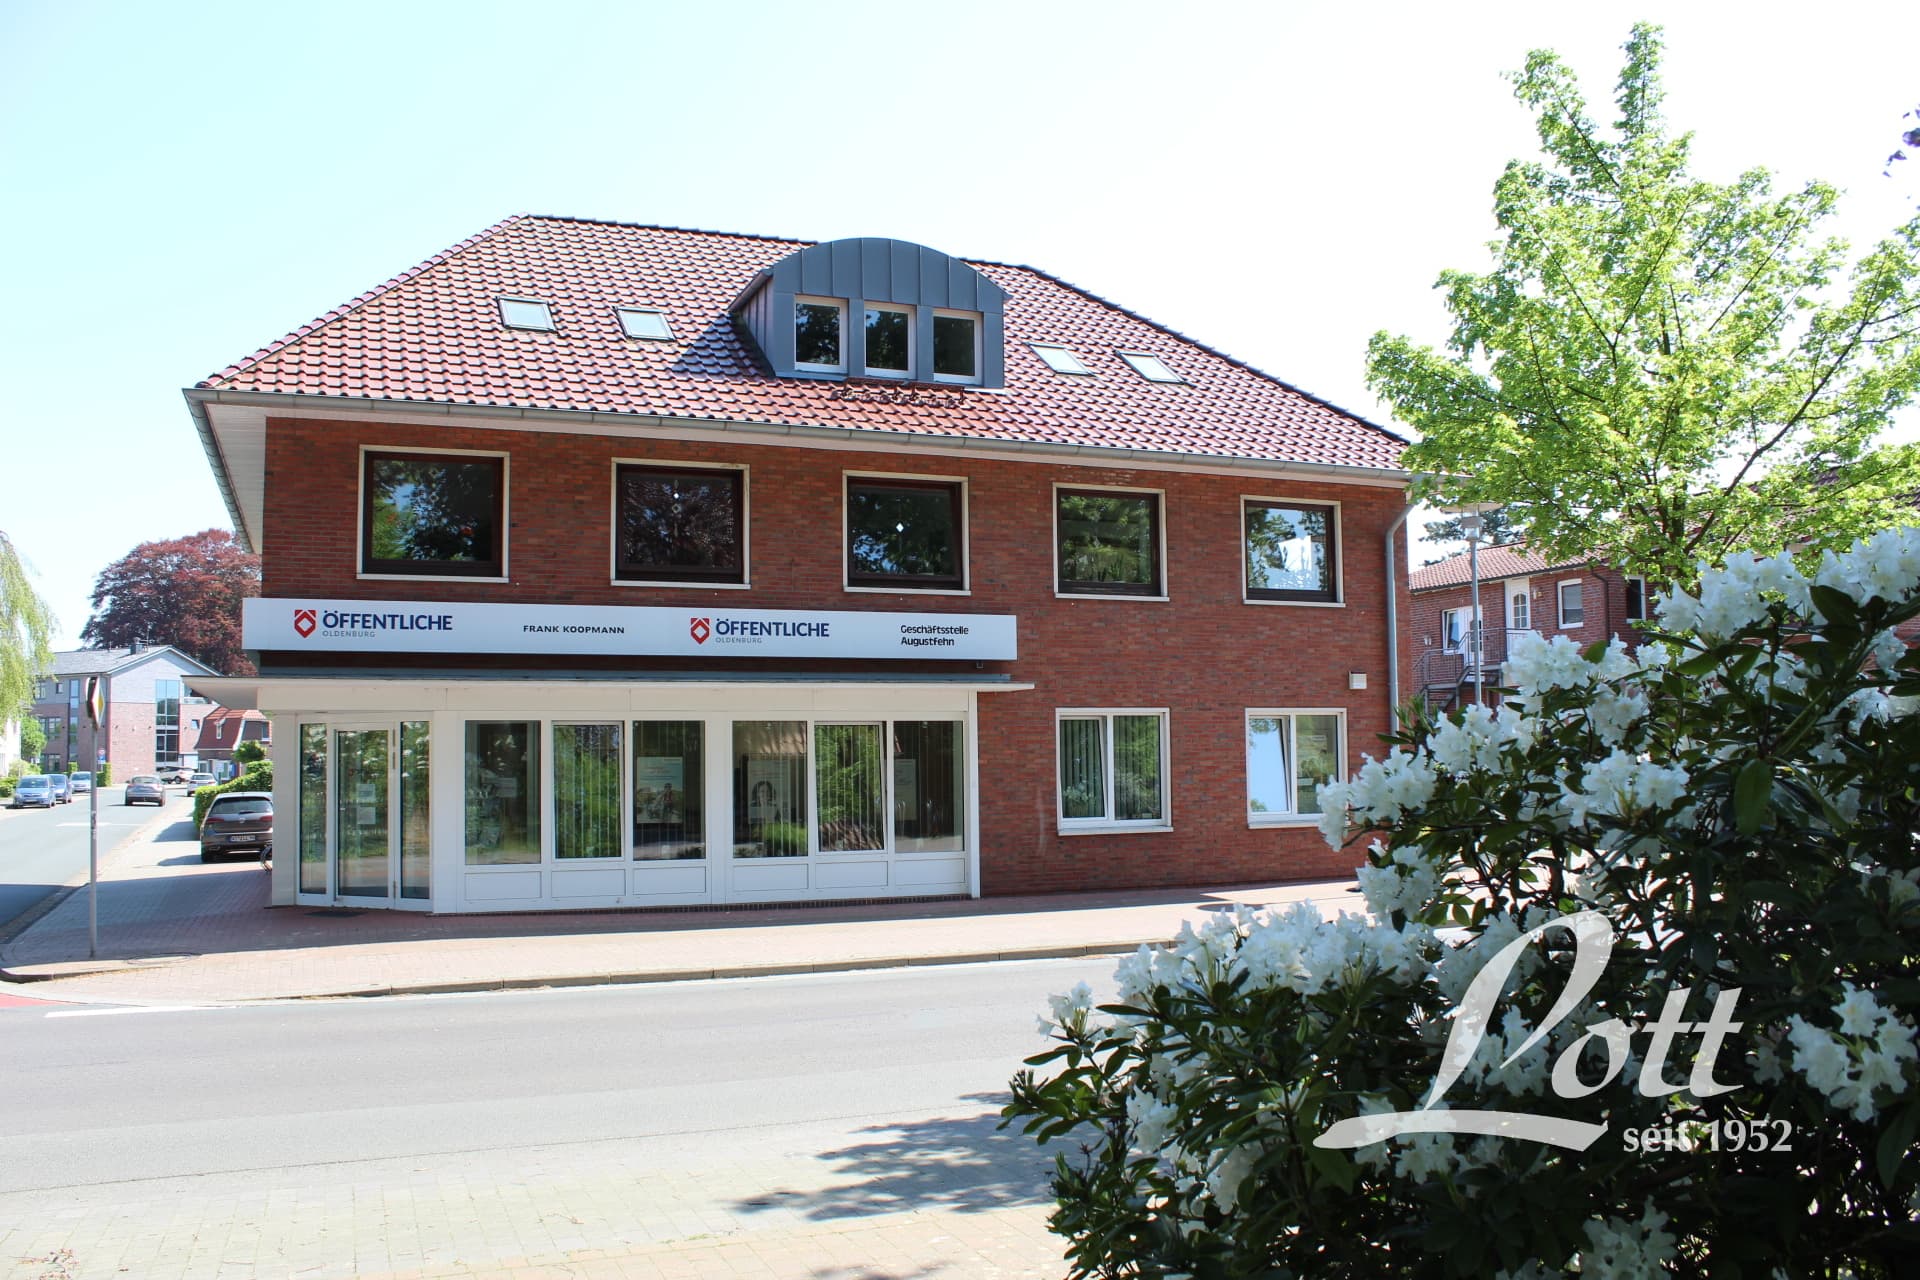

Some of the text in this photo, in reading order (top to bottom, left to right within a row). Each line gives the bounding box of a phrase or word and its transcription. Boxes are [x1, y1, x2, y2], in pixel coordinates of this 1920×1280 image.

[322, 610, 453, 630] ÖFFENTLICHE
[715, 618, 830, 637] ÖFFENTLICHE
[900, 625, 968, 634] Geschäftsstelle
[901, 636, 954, 646] Augustfehn
